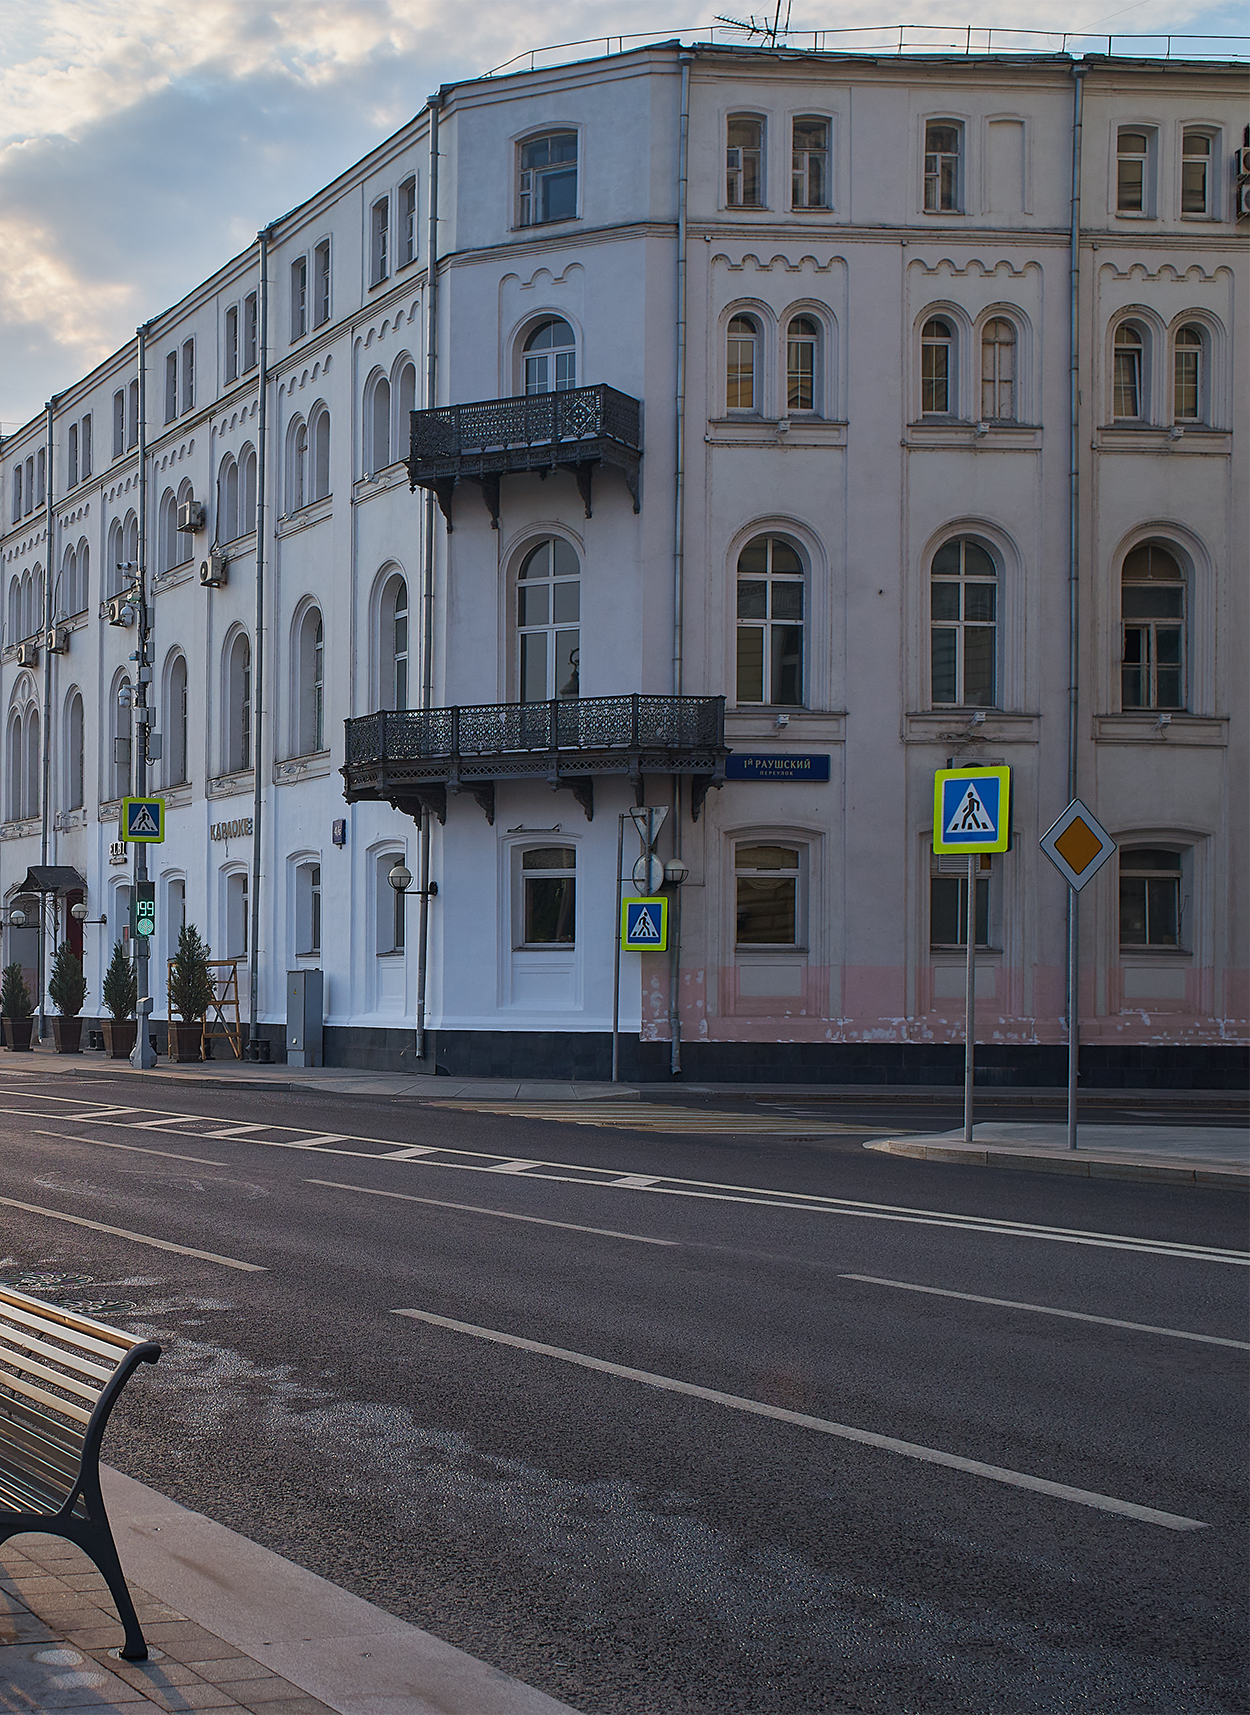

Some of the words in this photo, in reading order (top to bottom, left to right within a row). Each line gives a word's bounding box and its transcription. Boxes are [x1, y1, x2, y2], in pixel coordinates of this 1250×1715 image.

[755, 759, 811, 769] РАУШСКИЙ
[210, 817, 252, 841] КАРАОКЕ
[137, 901, 155, 916] 199
